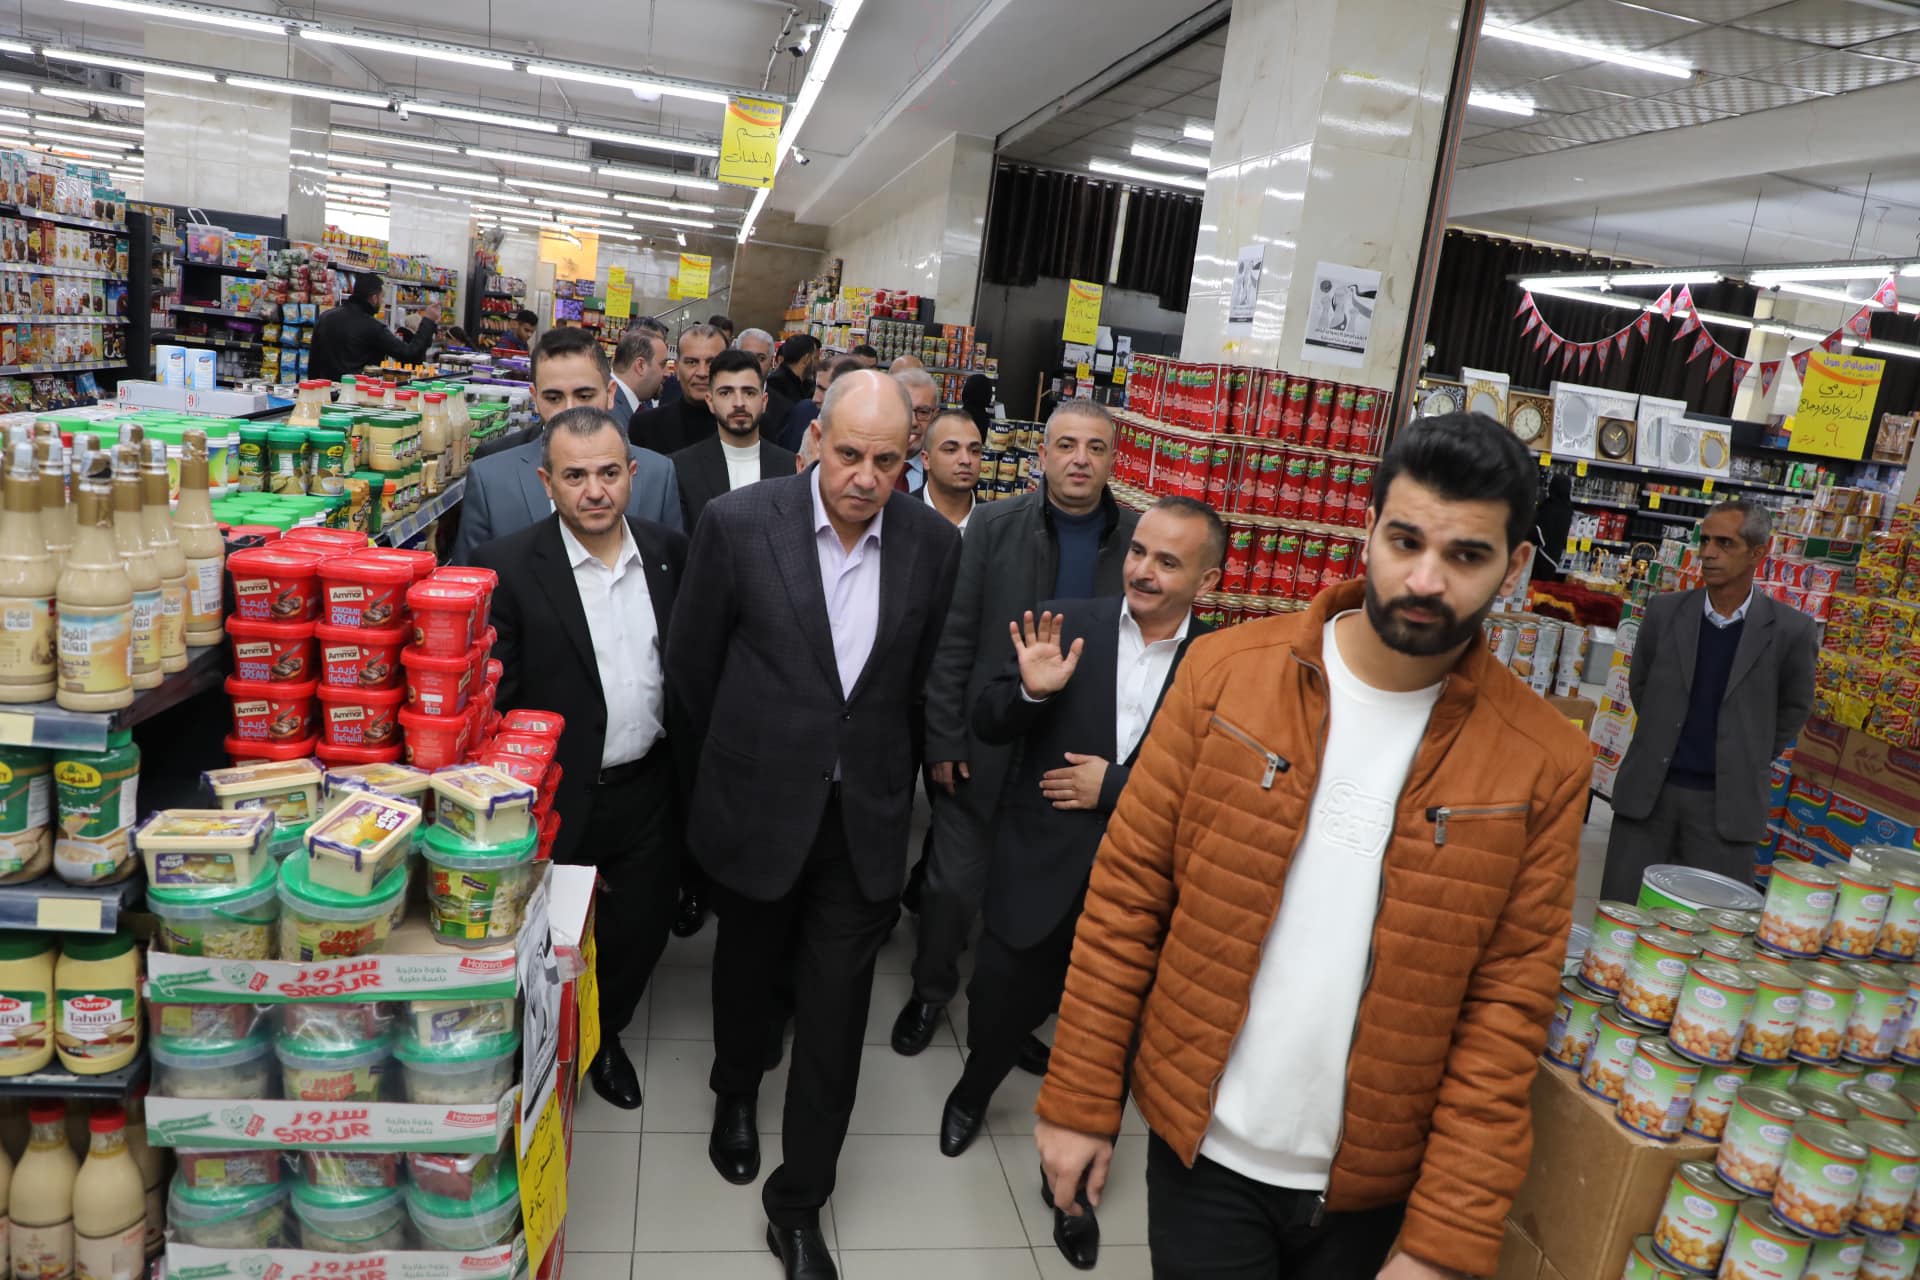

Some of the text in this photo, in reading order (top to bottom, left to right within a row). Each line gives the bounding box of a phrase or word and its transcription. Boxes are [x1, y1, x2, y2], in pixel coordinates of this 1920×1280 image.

[332, 591, 362, 600] Ammar
[332, 614, 360, 626] CREAM
[239, 669, 270, 681] CREAM
[467, 959, 503, 969] Halawa
[296, 959, 378, 983] سرور
[278, 973, 383, 998] SROUR
[69, 1012, 116, 1025] Tahina
[290, 1109, 368, 1126] سرور
[452, 1112, 490, 1122] Halawa
[272, 1124, 371, 1144] SROUR
[309, 1256, 385, 1272] سرور
